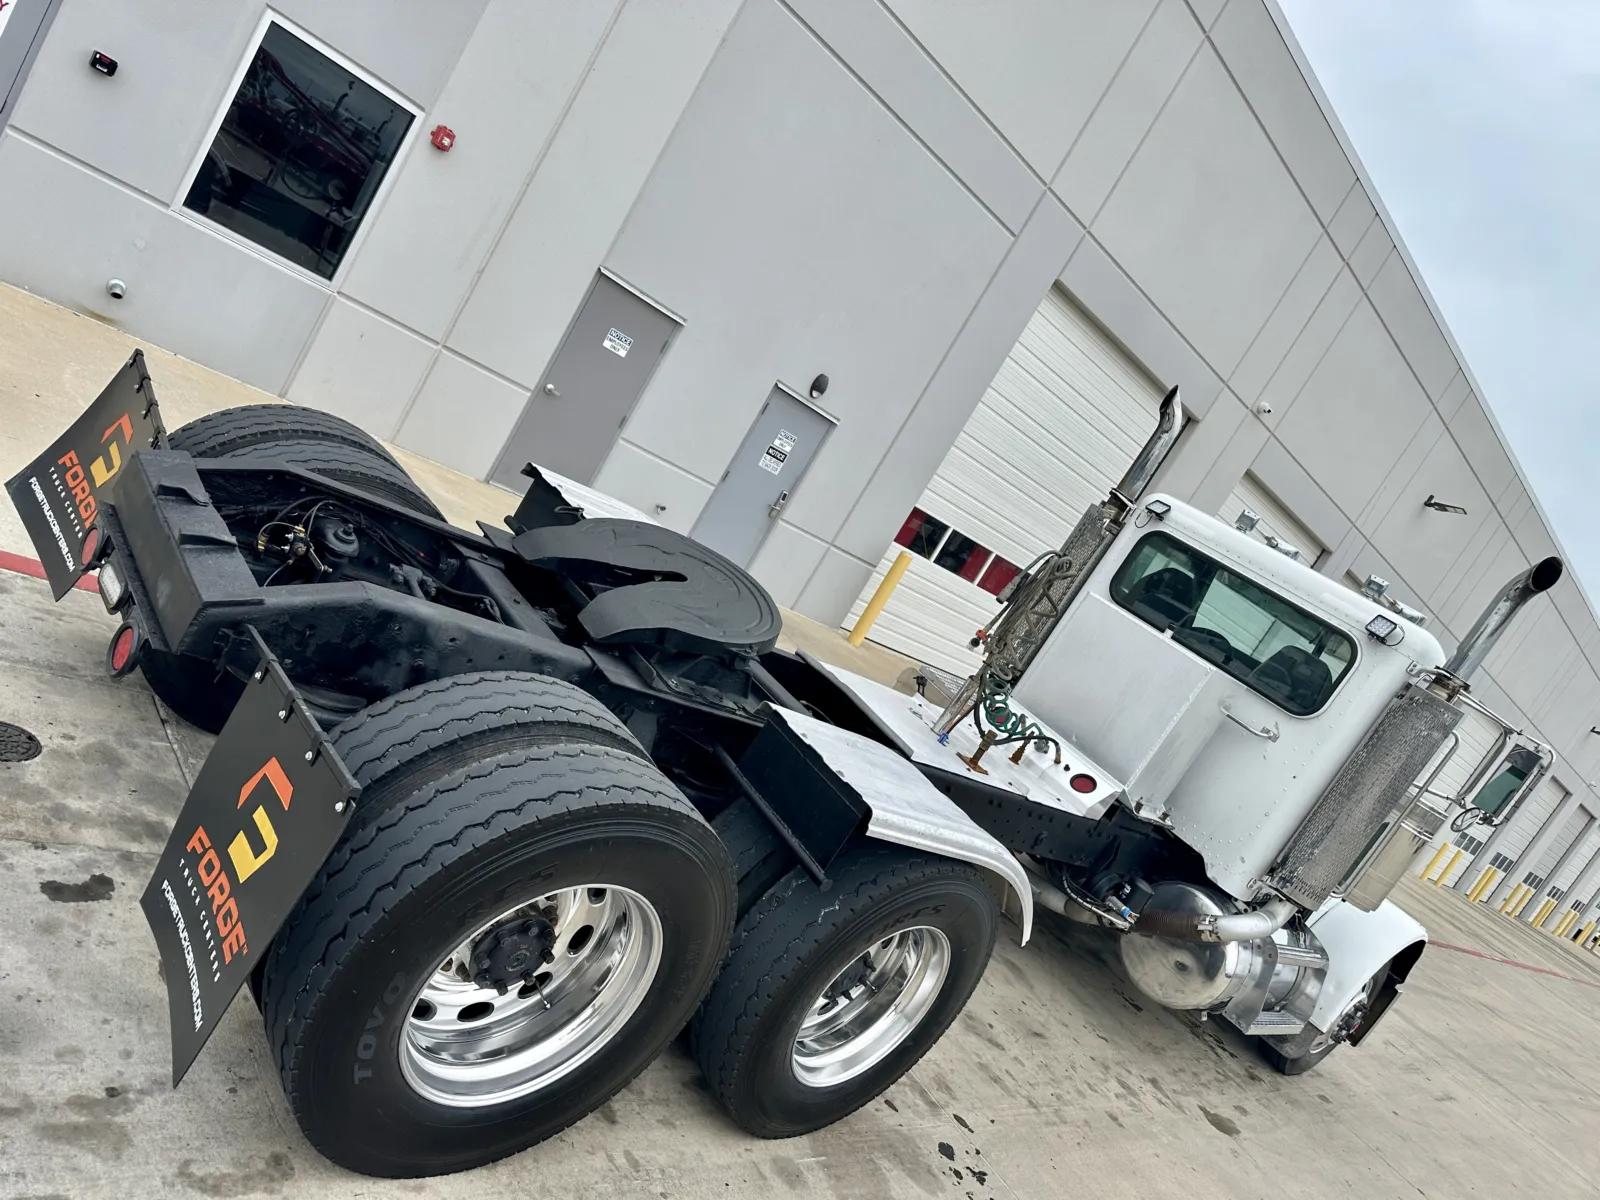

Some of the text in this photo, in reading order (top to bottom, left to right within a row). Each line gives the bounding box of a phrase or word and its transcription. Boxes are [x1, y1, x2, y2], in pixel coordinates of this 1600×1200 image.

[609, 329, 632, 347] NOTICE
[49, 466, 66, 499] TRUCK
[767, 448, 786, 462] NOTICE
[160, 879, 203, 1032] FORGETRUCKCENTERS.COM
[179, 857, 221, 983] TRUCK CENTERS
[353, 970, 406, 1085] TOYO
